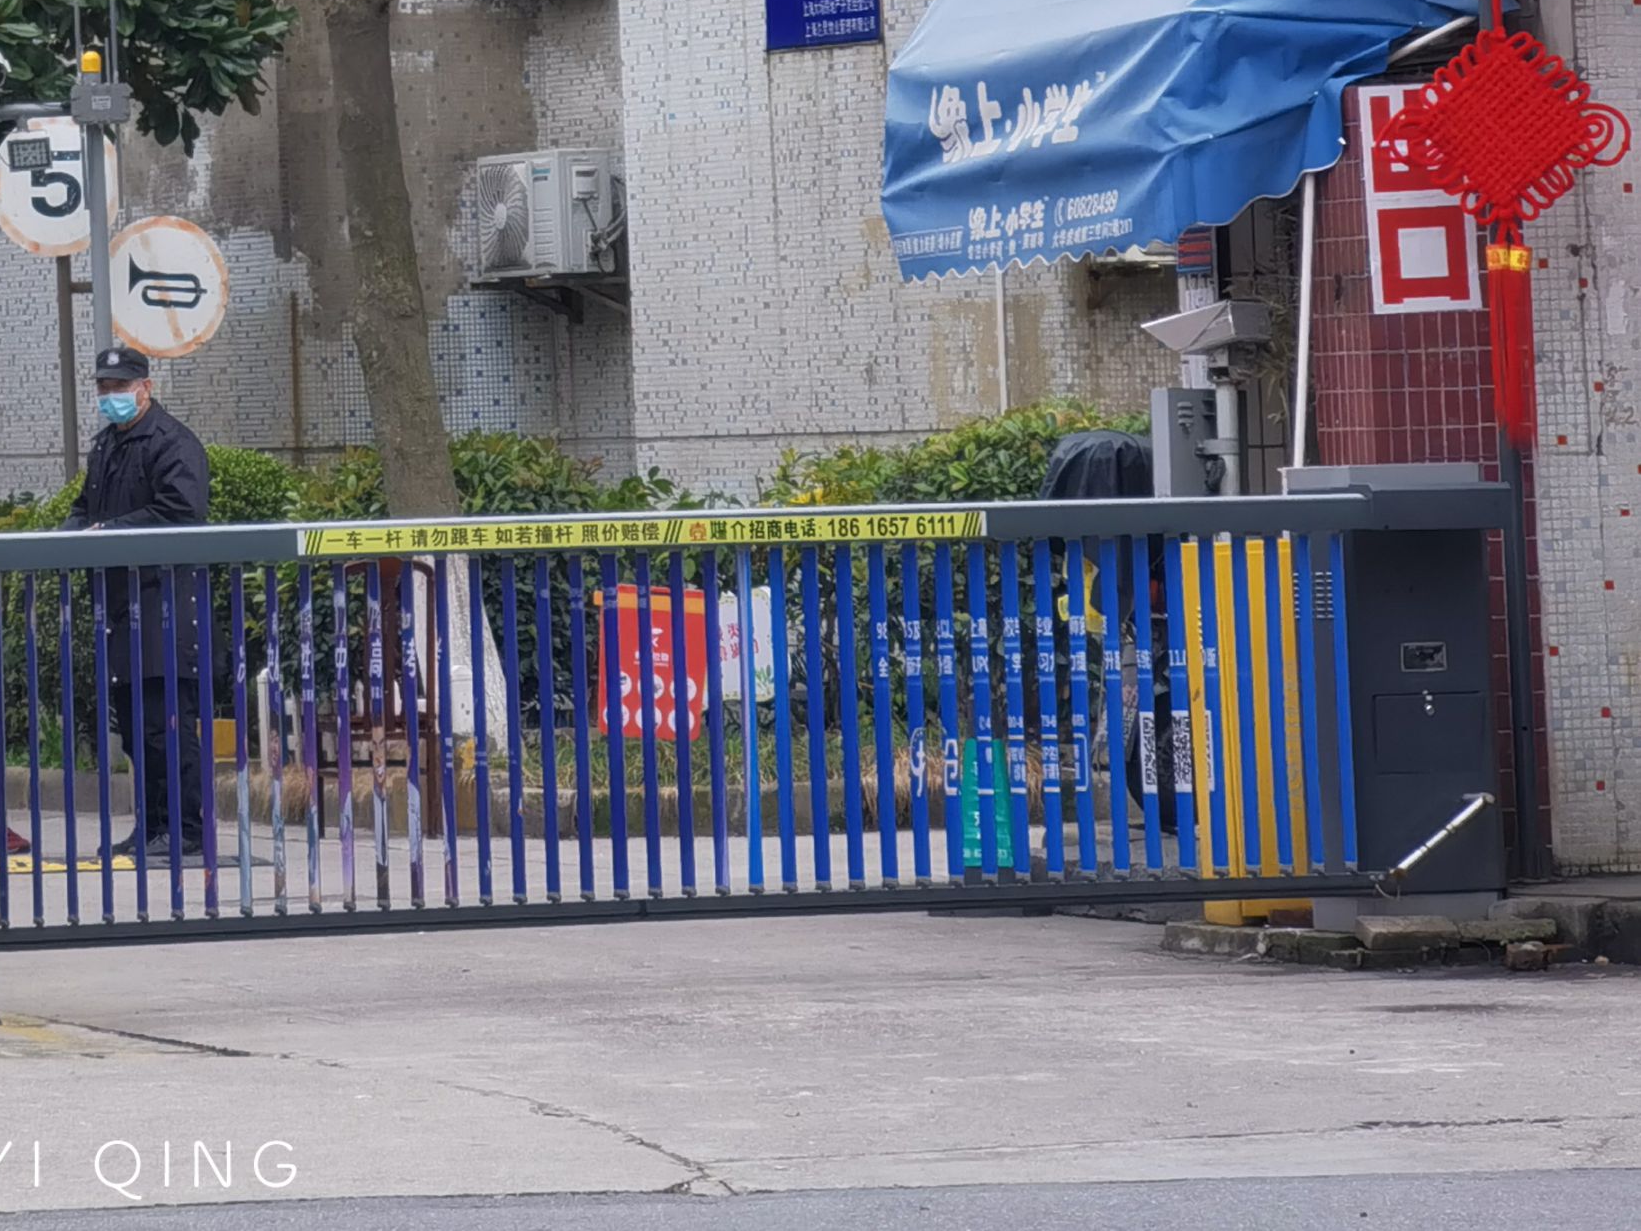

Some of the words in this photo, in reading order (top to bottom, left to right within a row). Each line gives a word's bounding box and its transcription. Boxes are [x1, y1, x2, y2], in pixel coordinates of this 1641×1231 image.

[31, 150, 82, 217] 5
[326, 530, 404, 550] 一车一杆
[411, 526, 489, 548] 请勿跟车
[496, 524, 574, 546] 如若撞杆
[582, 521, 660, 543] 照价赔偿
[828, 518, 859, 537] 186
[866, 516, 909, 537] 1657
[916, 516, 956, 536] 6111
